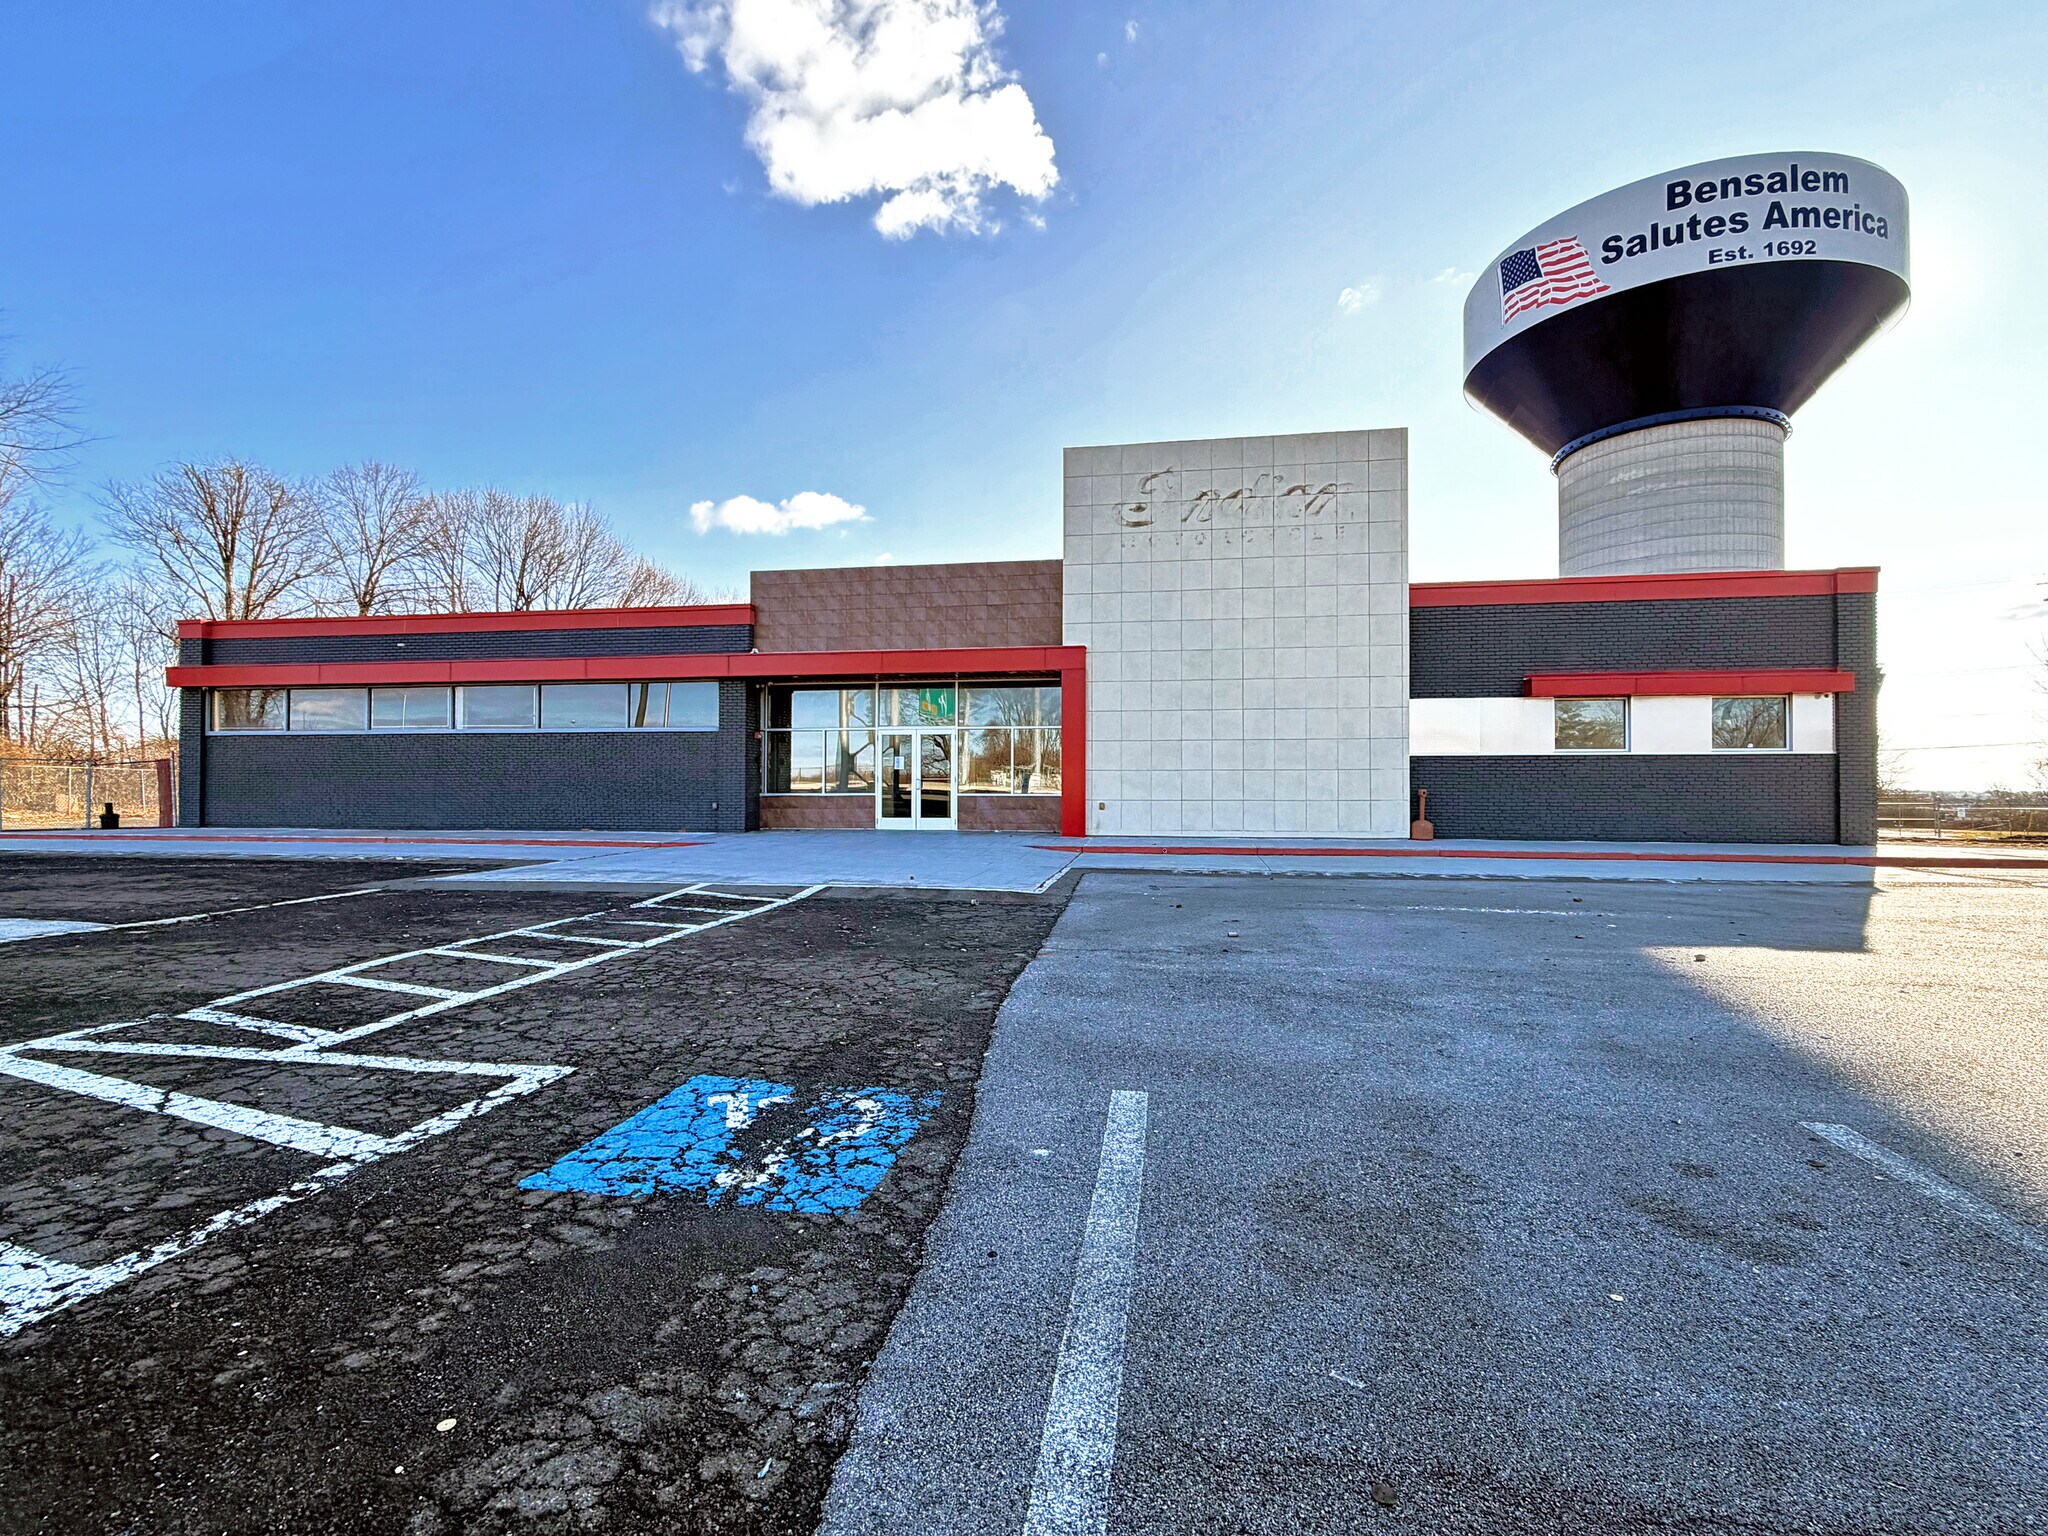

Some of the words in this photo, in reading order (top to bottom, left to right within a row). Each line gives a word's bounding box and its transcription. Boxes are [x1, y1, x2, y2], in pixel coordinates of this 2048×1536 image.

[1666, 164, 1849, 211] Bensalem
[1601, 211, 1750, 265] Salutes
[1762, 200, 1889, 239] America
[1708, 246, 1754, 264] Est.
[1763, 240, 1817, 257] 1692
